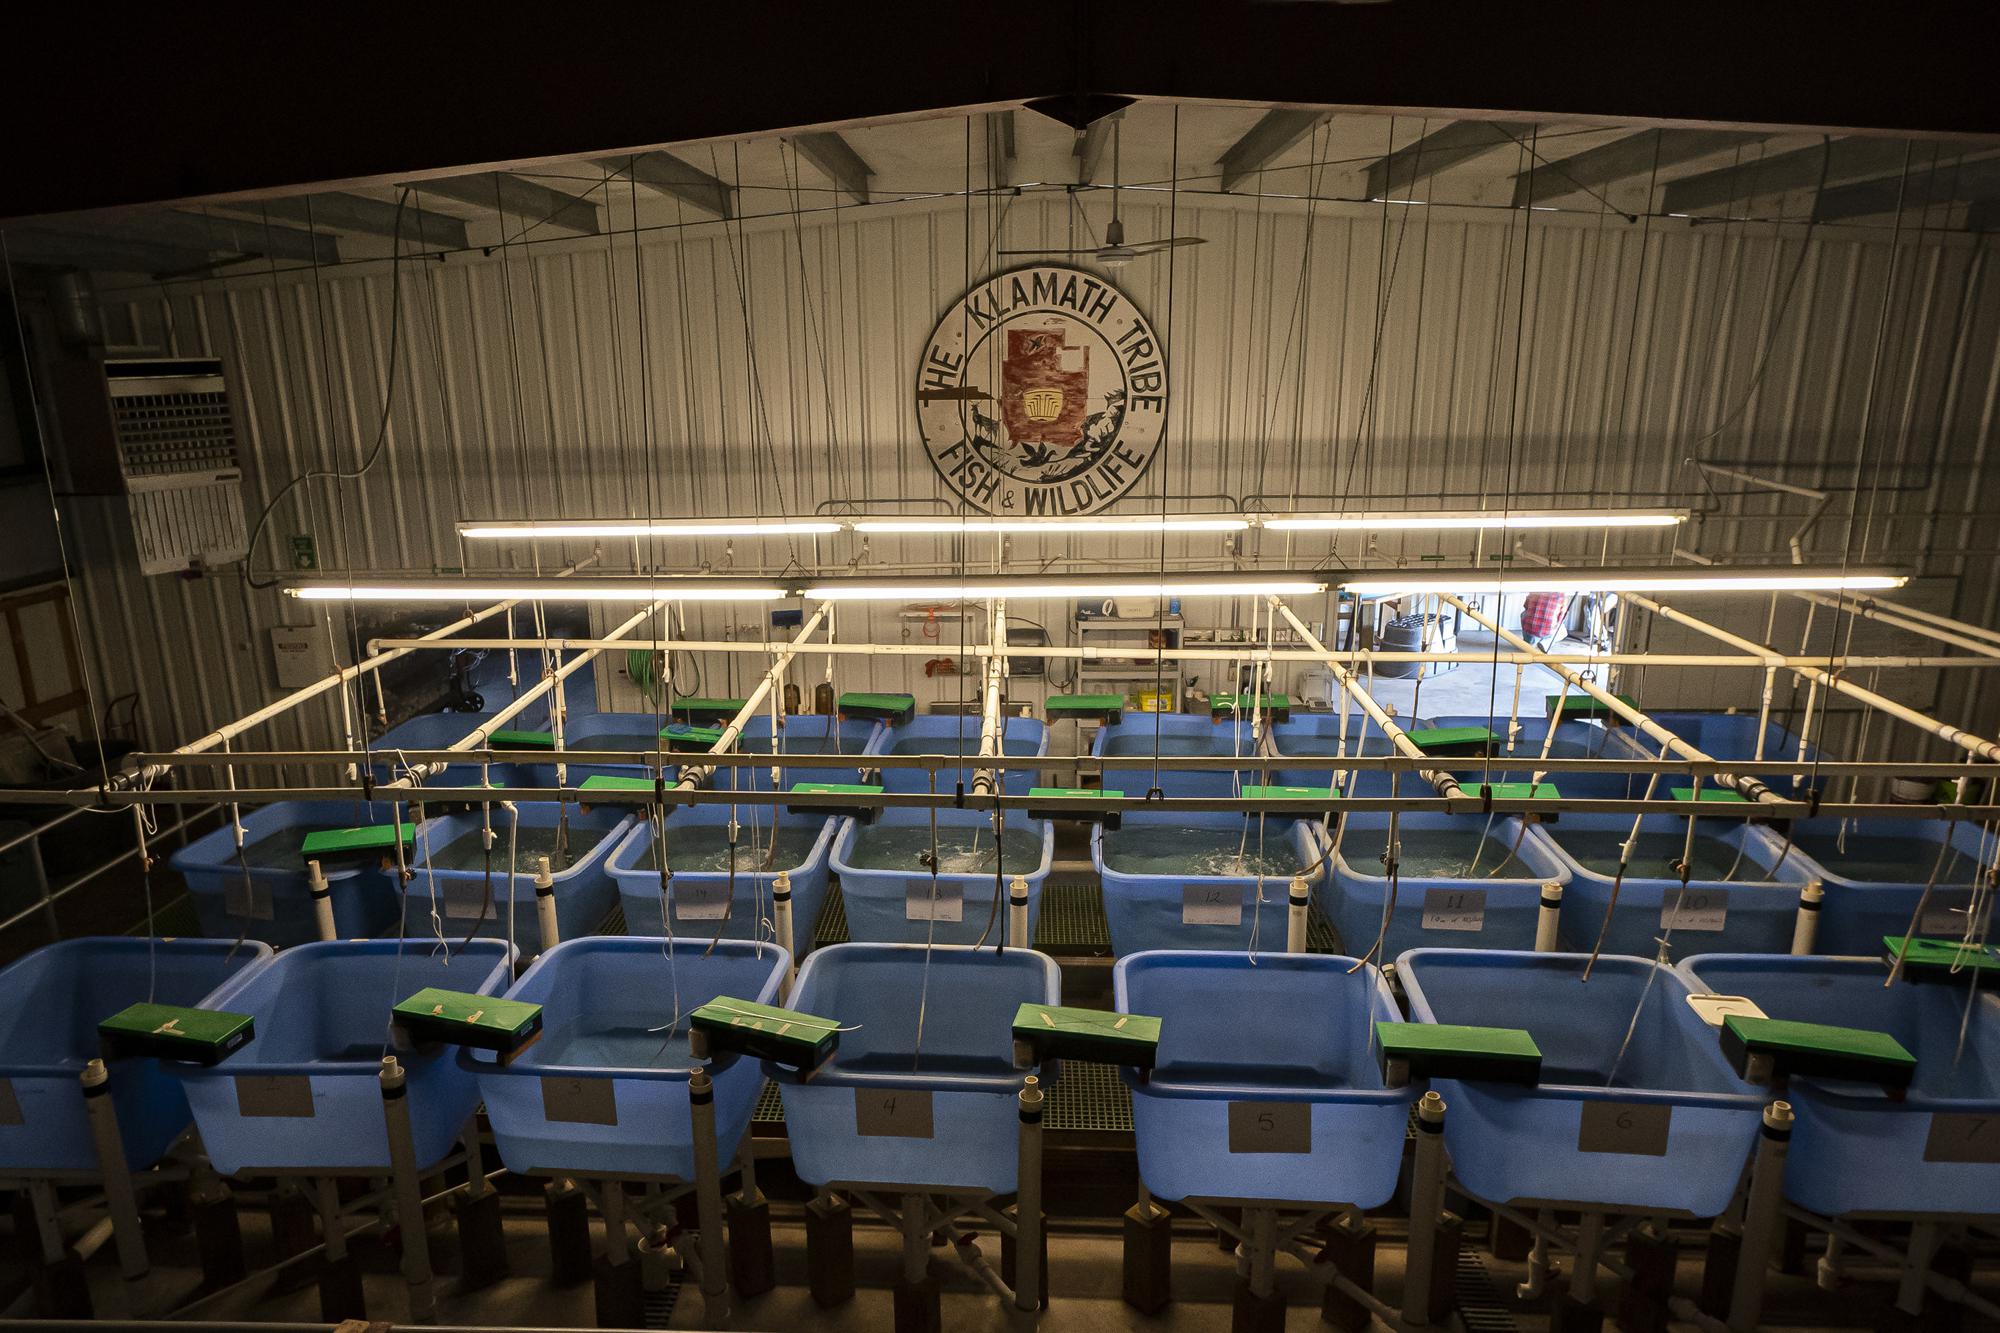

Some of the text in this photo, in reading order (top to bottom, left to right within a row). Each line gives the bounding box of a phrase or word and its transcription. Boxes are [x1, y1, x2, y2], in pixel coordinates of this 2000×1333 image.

[964, 271, 1118, 330] KLAMATH
[1115, 317, 1164, 413] TRIBE
[937, 439, 1145, 516] FISH & WILDLIFE
[1205, 891, 1221, 904] 12
[1447, 894, 1465, 908] 11
[1683, 895, 1709, 910] 10
[569, 1080, 582, 1094] 3
[883, 1097, 896, 1115] 4
[1258, 1112, 1275, 1131] 5
[1616, 1110, 1633, 1129] 6
[1967, 1118, 1987, 1142] 7
